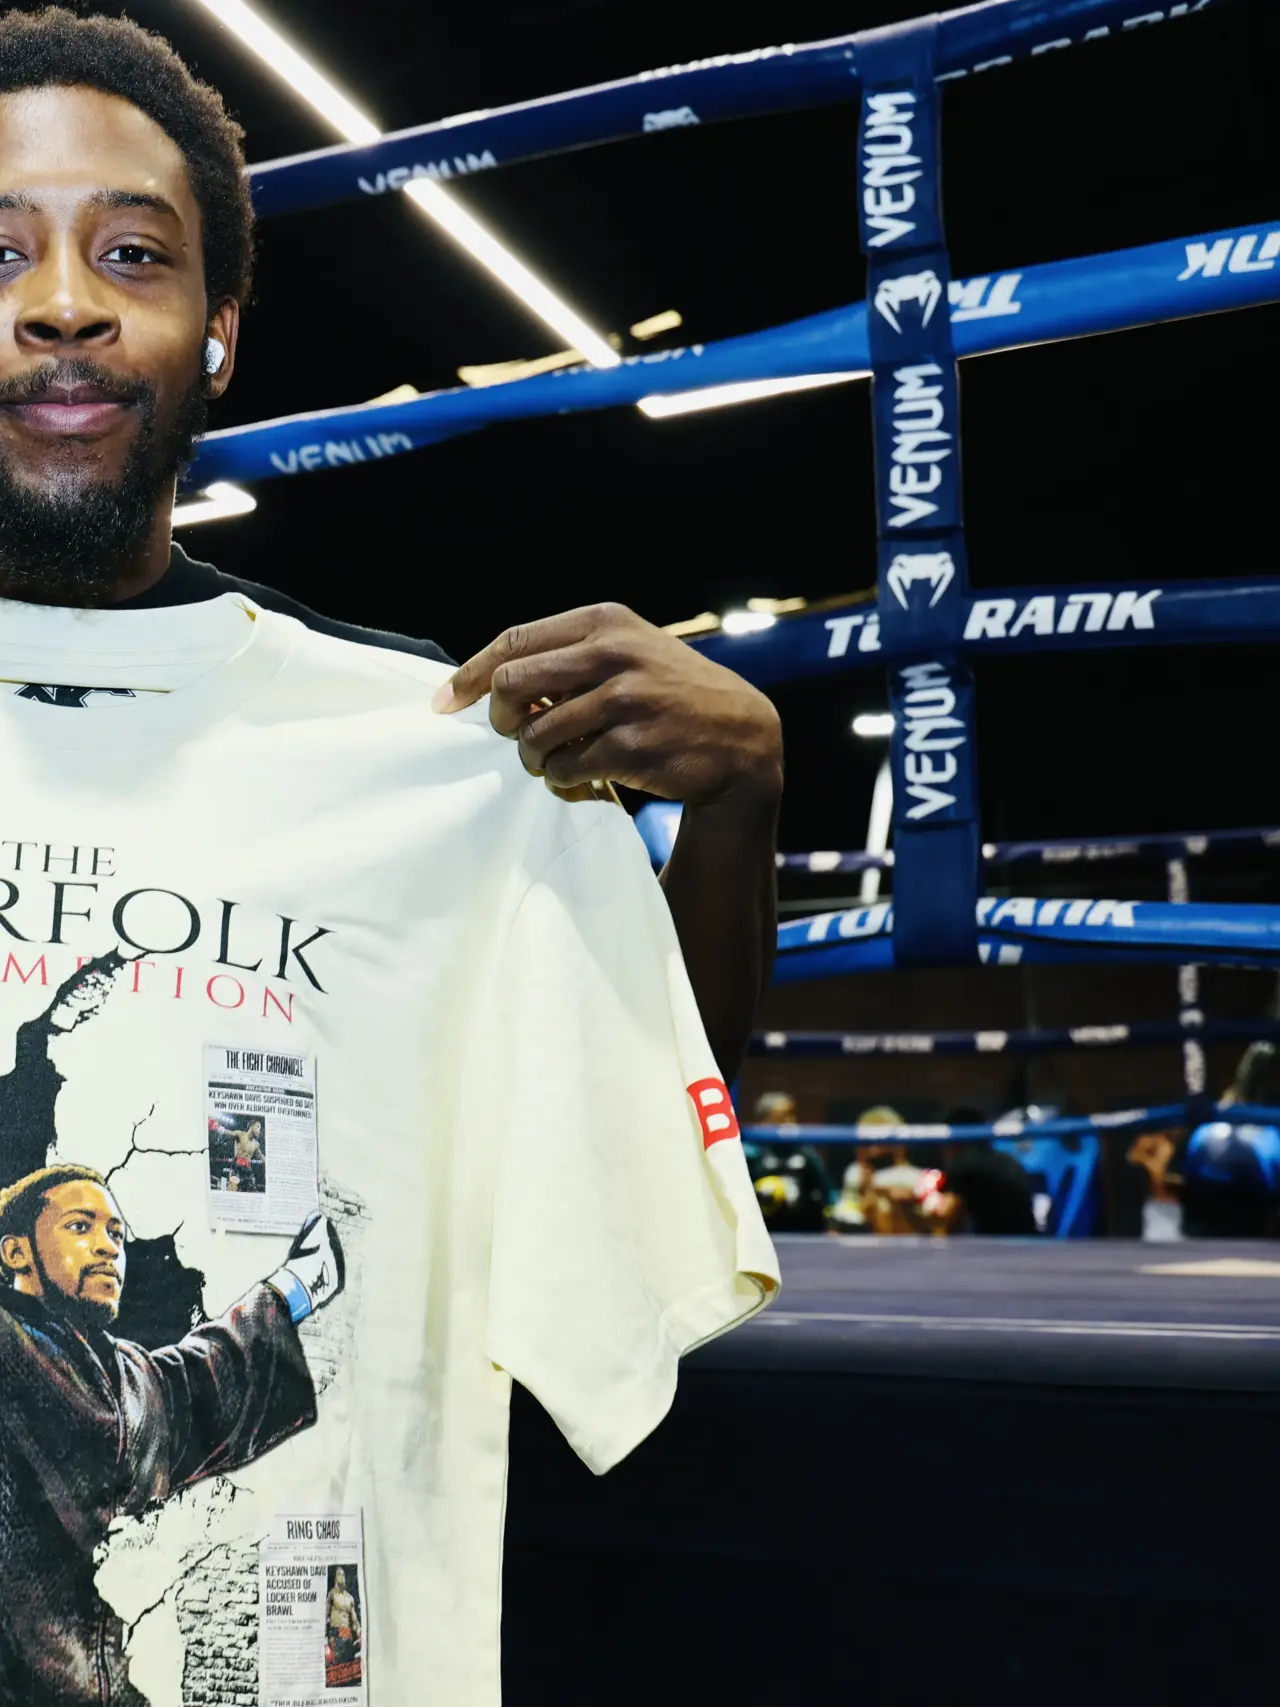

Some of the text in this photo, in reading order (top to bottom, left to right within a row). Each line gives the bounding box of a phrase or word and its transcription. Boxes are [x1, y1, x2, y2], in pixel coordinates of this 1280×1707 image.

[862, 91, 923, 248] VENUM
[887, 363, 953, 528] VENUM
[963, 589, 1163, 640] RANK
[898, 661, 967, 820] VENUM
[2, 840, 117, 877] THE
[226, 1050, 240, 1069] THE
[242, 1052, 264, 1072] FIGHT
[266, 1054, 304, 1077] CHRONICLE
[208, 1090, 243, 1100] KEYSHAWN
[244, 1092, 262, 1102] DAVIS
[263, 1095, 294, 1106] SUSPENDED
[214, 1101, 227, 1109] WIN
[246, 1104, 276, 1114] ALBRIGHT
[287, 1520, 340, 1540] RING CHAOS
[265, 1565, 309, 1576] KEYSHAWN
[266, 1579, 312, 1590] ACCUSED OF
[266, 1592, 317, 1603] LOCKER ROOM
[266, 1605, 294, 1616] BRAWL
